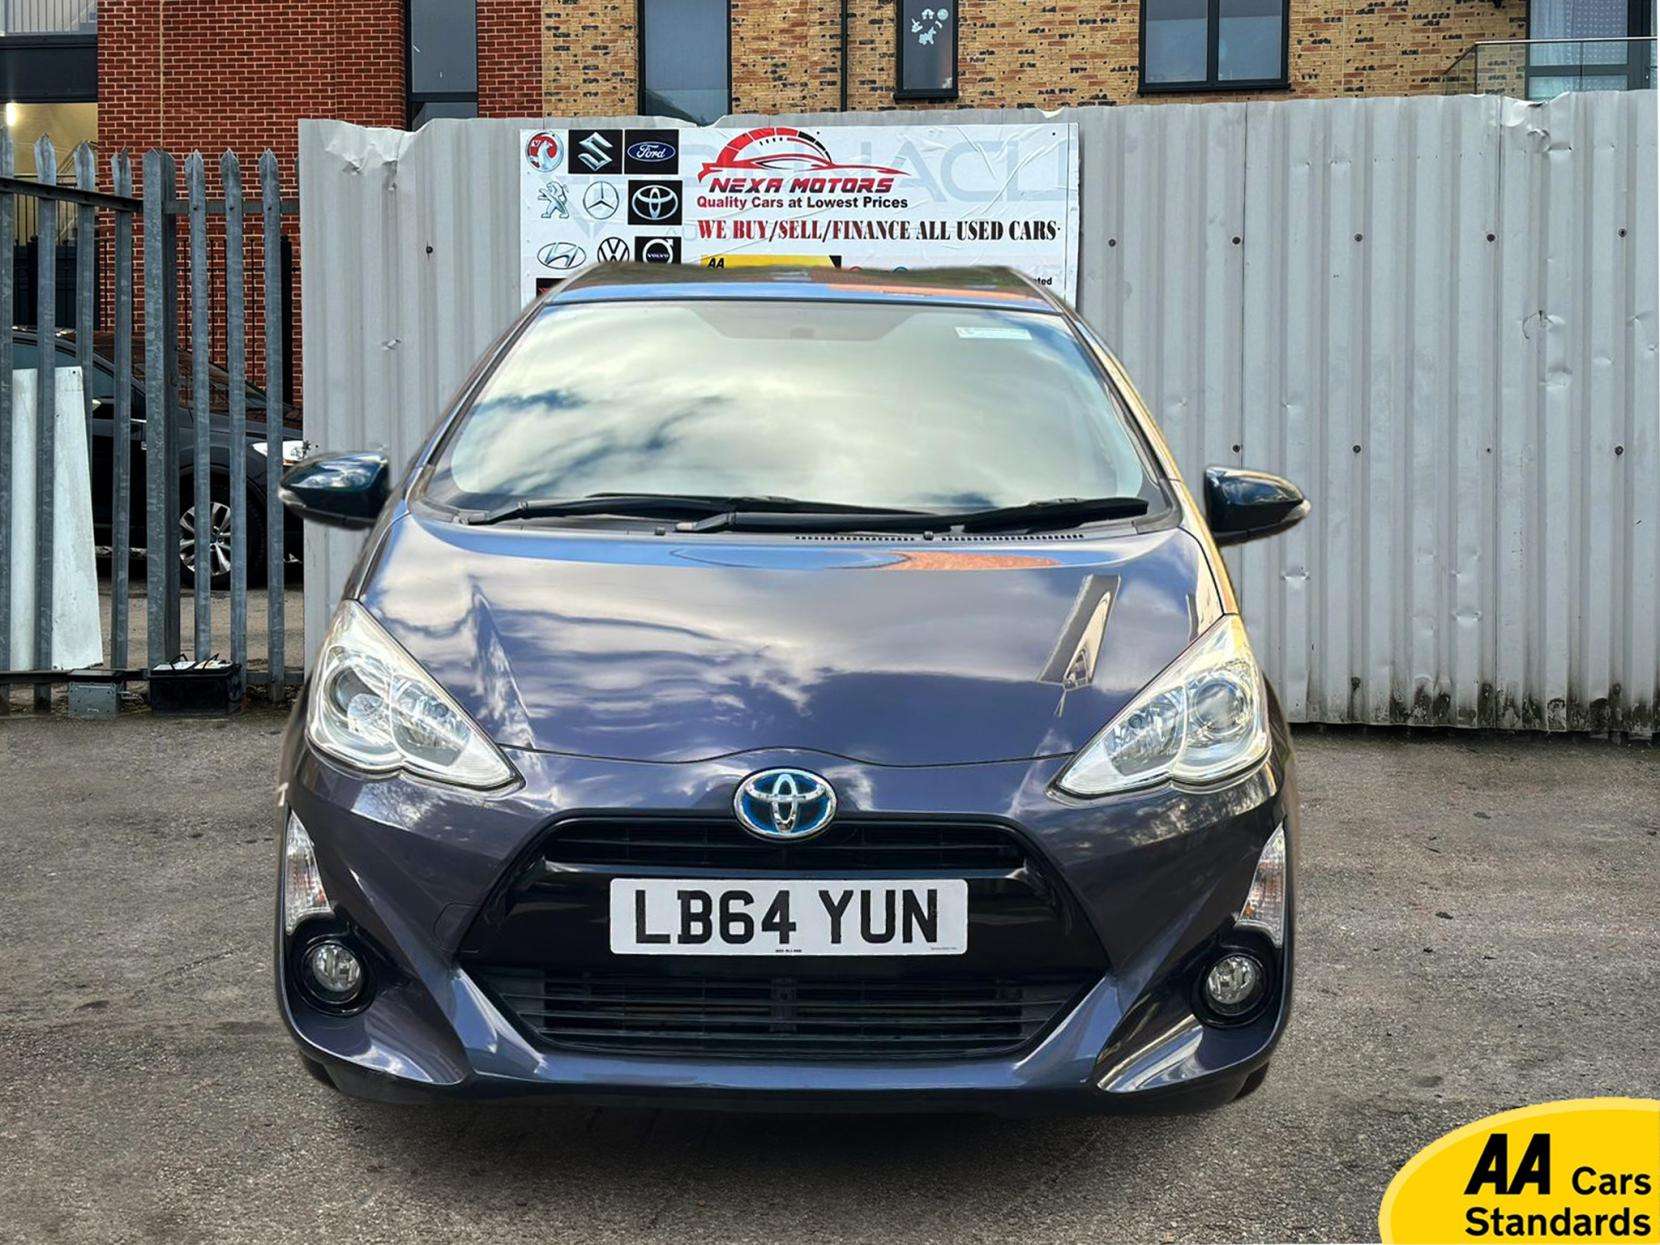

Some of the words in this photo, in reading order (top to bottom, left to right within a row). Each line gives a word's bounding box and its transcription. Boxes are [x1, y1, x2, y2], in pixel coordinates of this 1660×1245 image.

[636, 143, 666, 159] Ford
[709, 177, 783, 194] NEXA
[789, 177, 895, 194] MOTORS
[697, 195, 746, 211] Quality
[751, 196, 784, 209] Cars
[788, 196, 803, 209] at
[807, 196, 861, 209] Lowest
[863, 196, 909, 209] Prices
[697, 220, 727, 241] WE
[732, 219, 911, 243] BUY/SELL/FINANCE
[916, 220, 951, 241] ALL
[956, 220, 1004, 241] USED
[1008, 220, 1057, 241] CARS
[708, 257, 725, 269] AA
[635, 889, 797, 944] LB64
[818, 889, 938, 943] YUN
